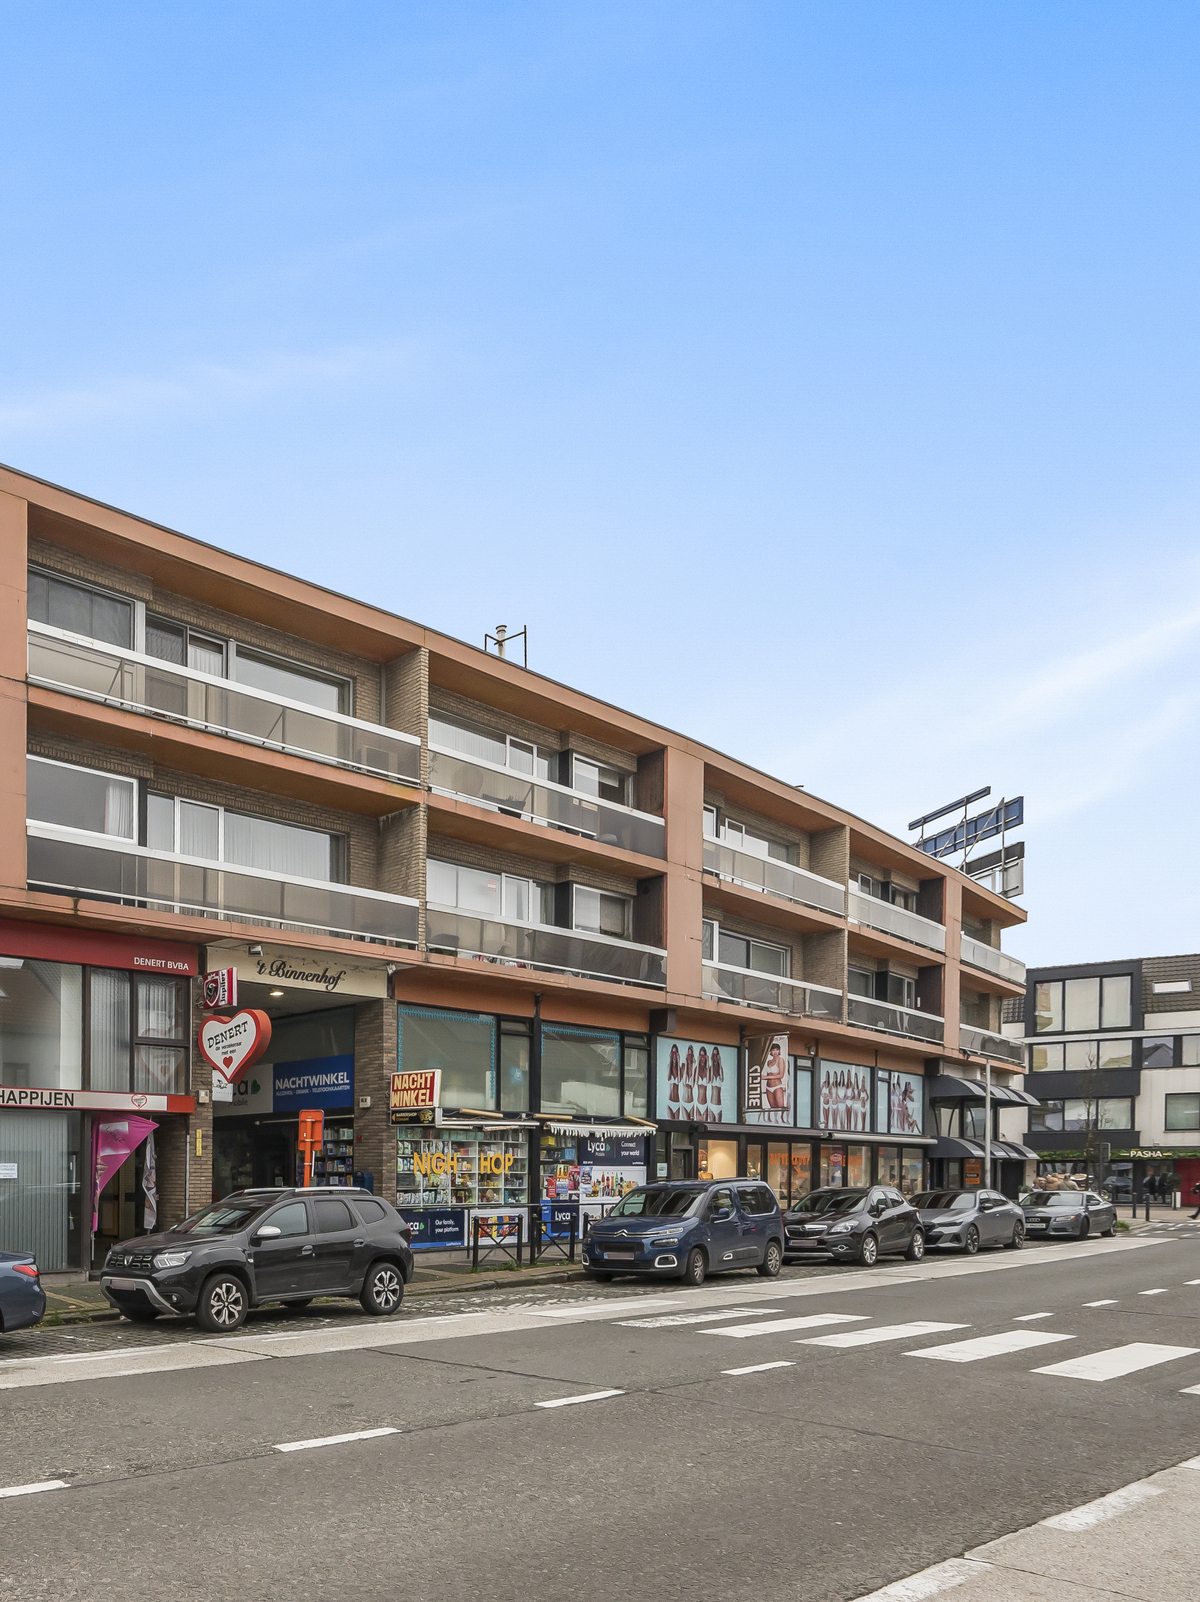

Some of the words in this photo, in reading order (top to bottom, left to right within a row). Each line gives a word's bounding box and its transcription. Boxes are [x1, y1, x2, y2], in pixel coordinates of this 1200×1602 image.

[134, 957, 166, 968] DENERT
[167, 960, 189, 971] BVBA
[269, 959, 346, 991] Binnenhof
[207, 1021, 249, 1049] DENERT
[275, 1072, 350, 1091] NACHTWINKEL
[394, 1072, 433, 1090] NACHT
[391, 1089, 433, 1107] WINKEL
[587, 1140, 605, 1153] Lyca
[1130, 1150, 1163, 1158] PASHA
[481, 1153, 514, 1174] HOP
[555, 1211, 571, 1221] Lyca
